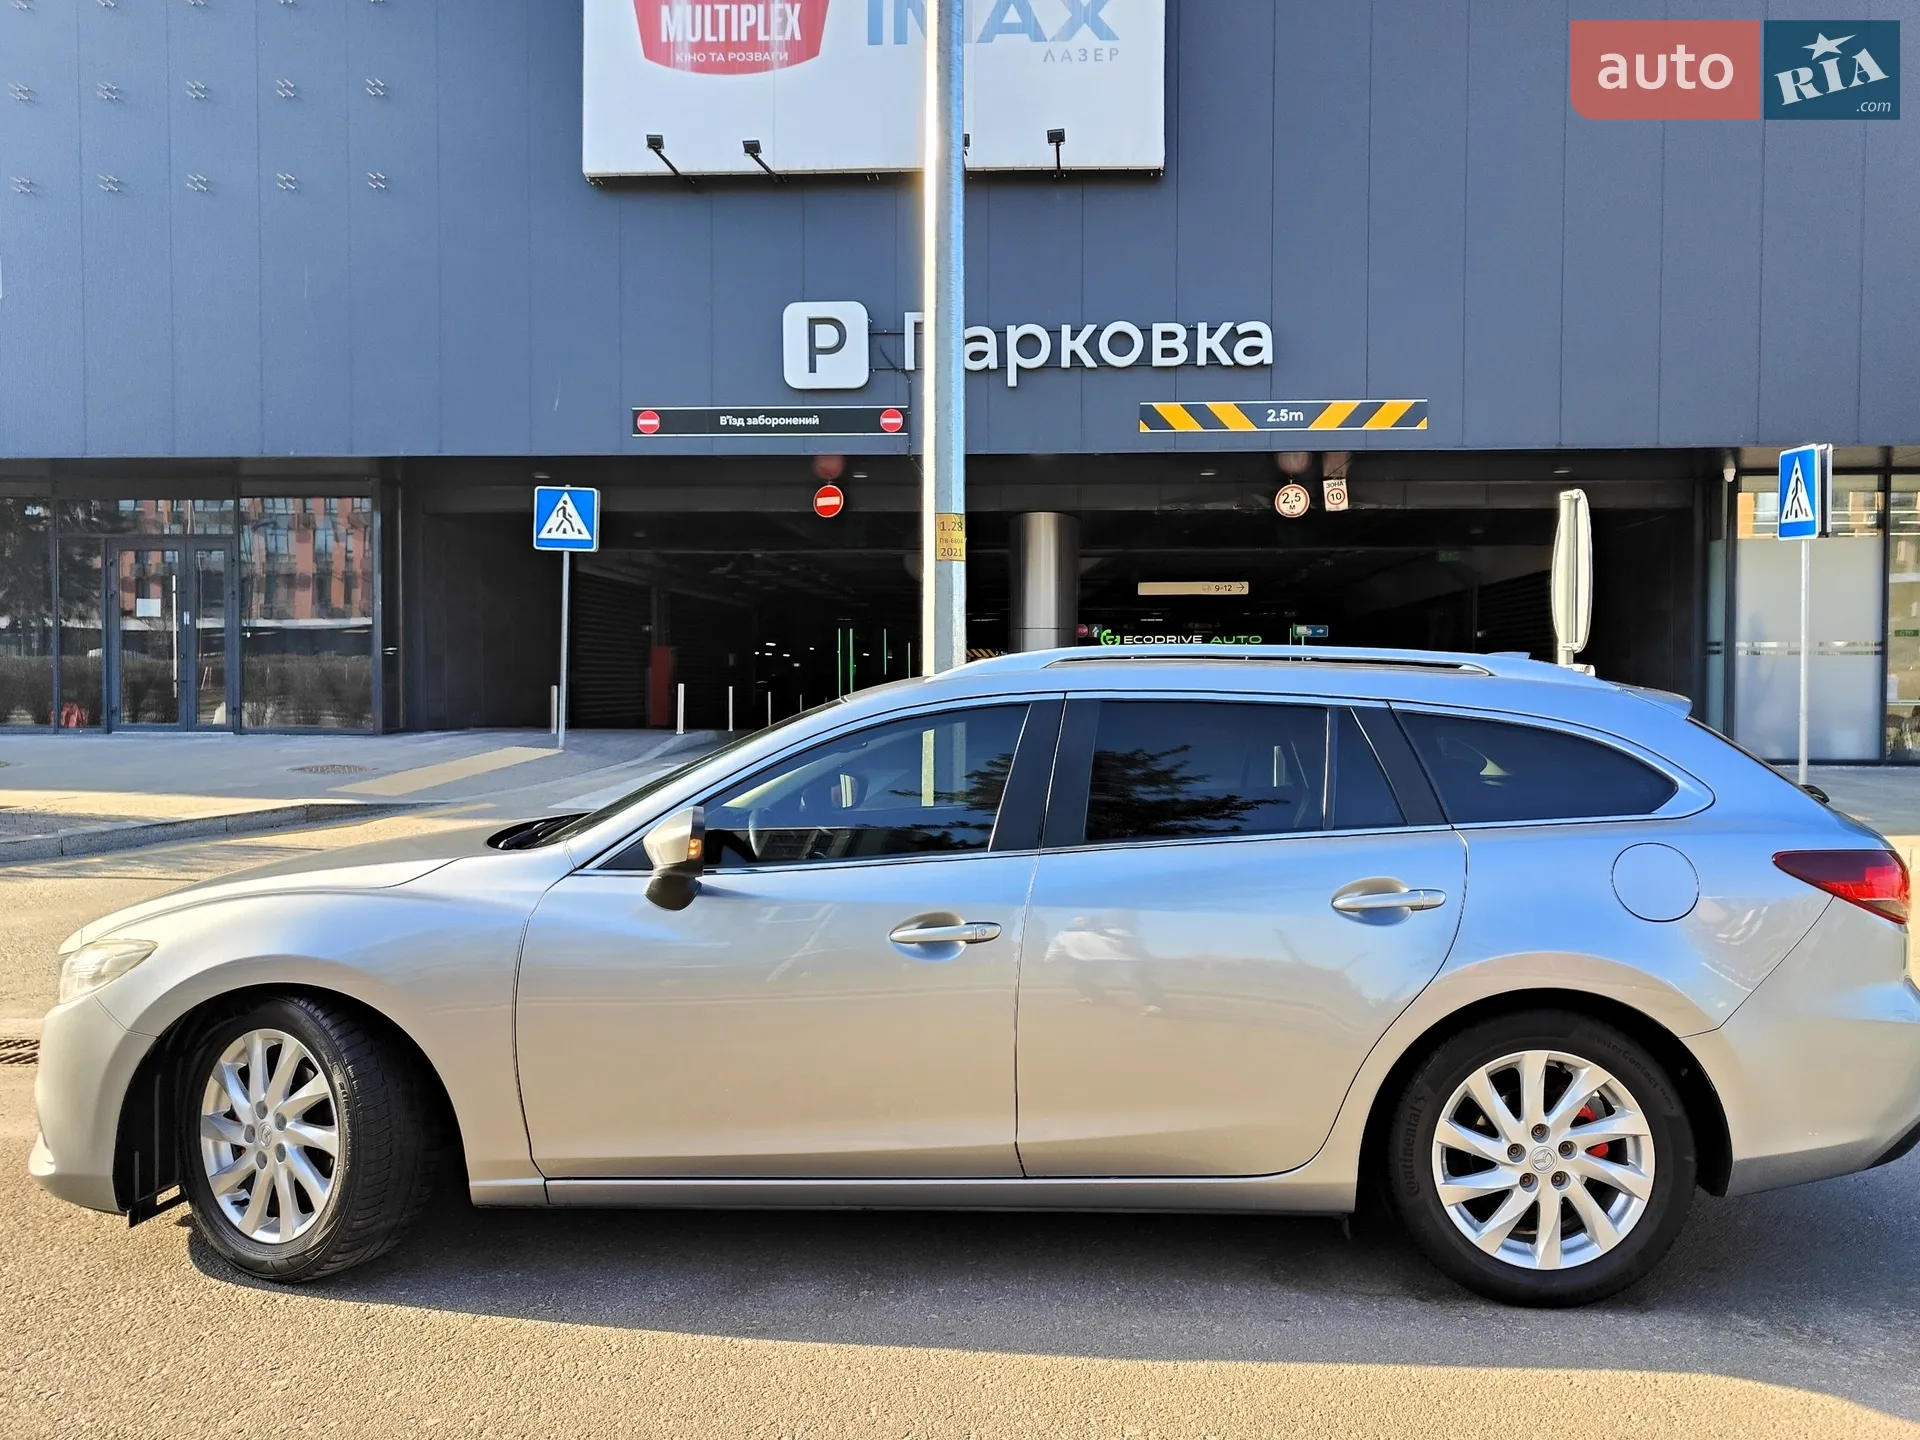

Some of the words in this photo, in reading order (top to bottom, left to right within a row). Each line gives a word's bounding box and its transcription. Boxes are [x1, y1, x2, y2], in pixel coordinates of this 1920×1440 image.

[661, 4, 801, 43] MULTIPLEX
[676, 53, 706, 63] КІНО
[709, 53, 725, 62] ТА
[728, 52, 789, 62] РОЗВАГИ
[1043, 48, 1119, 62] ЛАЗЕР
[1266, 408, 1304, 422] 2.5m
[746, 415, 820, 427] заборонений
[1326, 481, 1344, 489] ЗОНА
[1282, 492, 1301, 505] 2,5
[1330, 493, 1342, 501] 10
[940, 521, 963, 532] 1.28
[940, 547, 963, 557] 2021
[1123, 635, 1203, 644] ECODRIVE
[1210, 635, 1262, 644] AUTO
